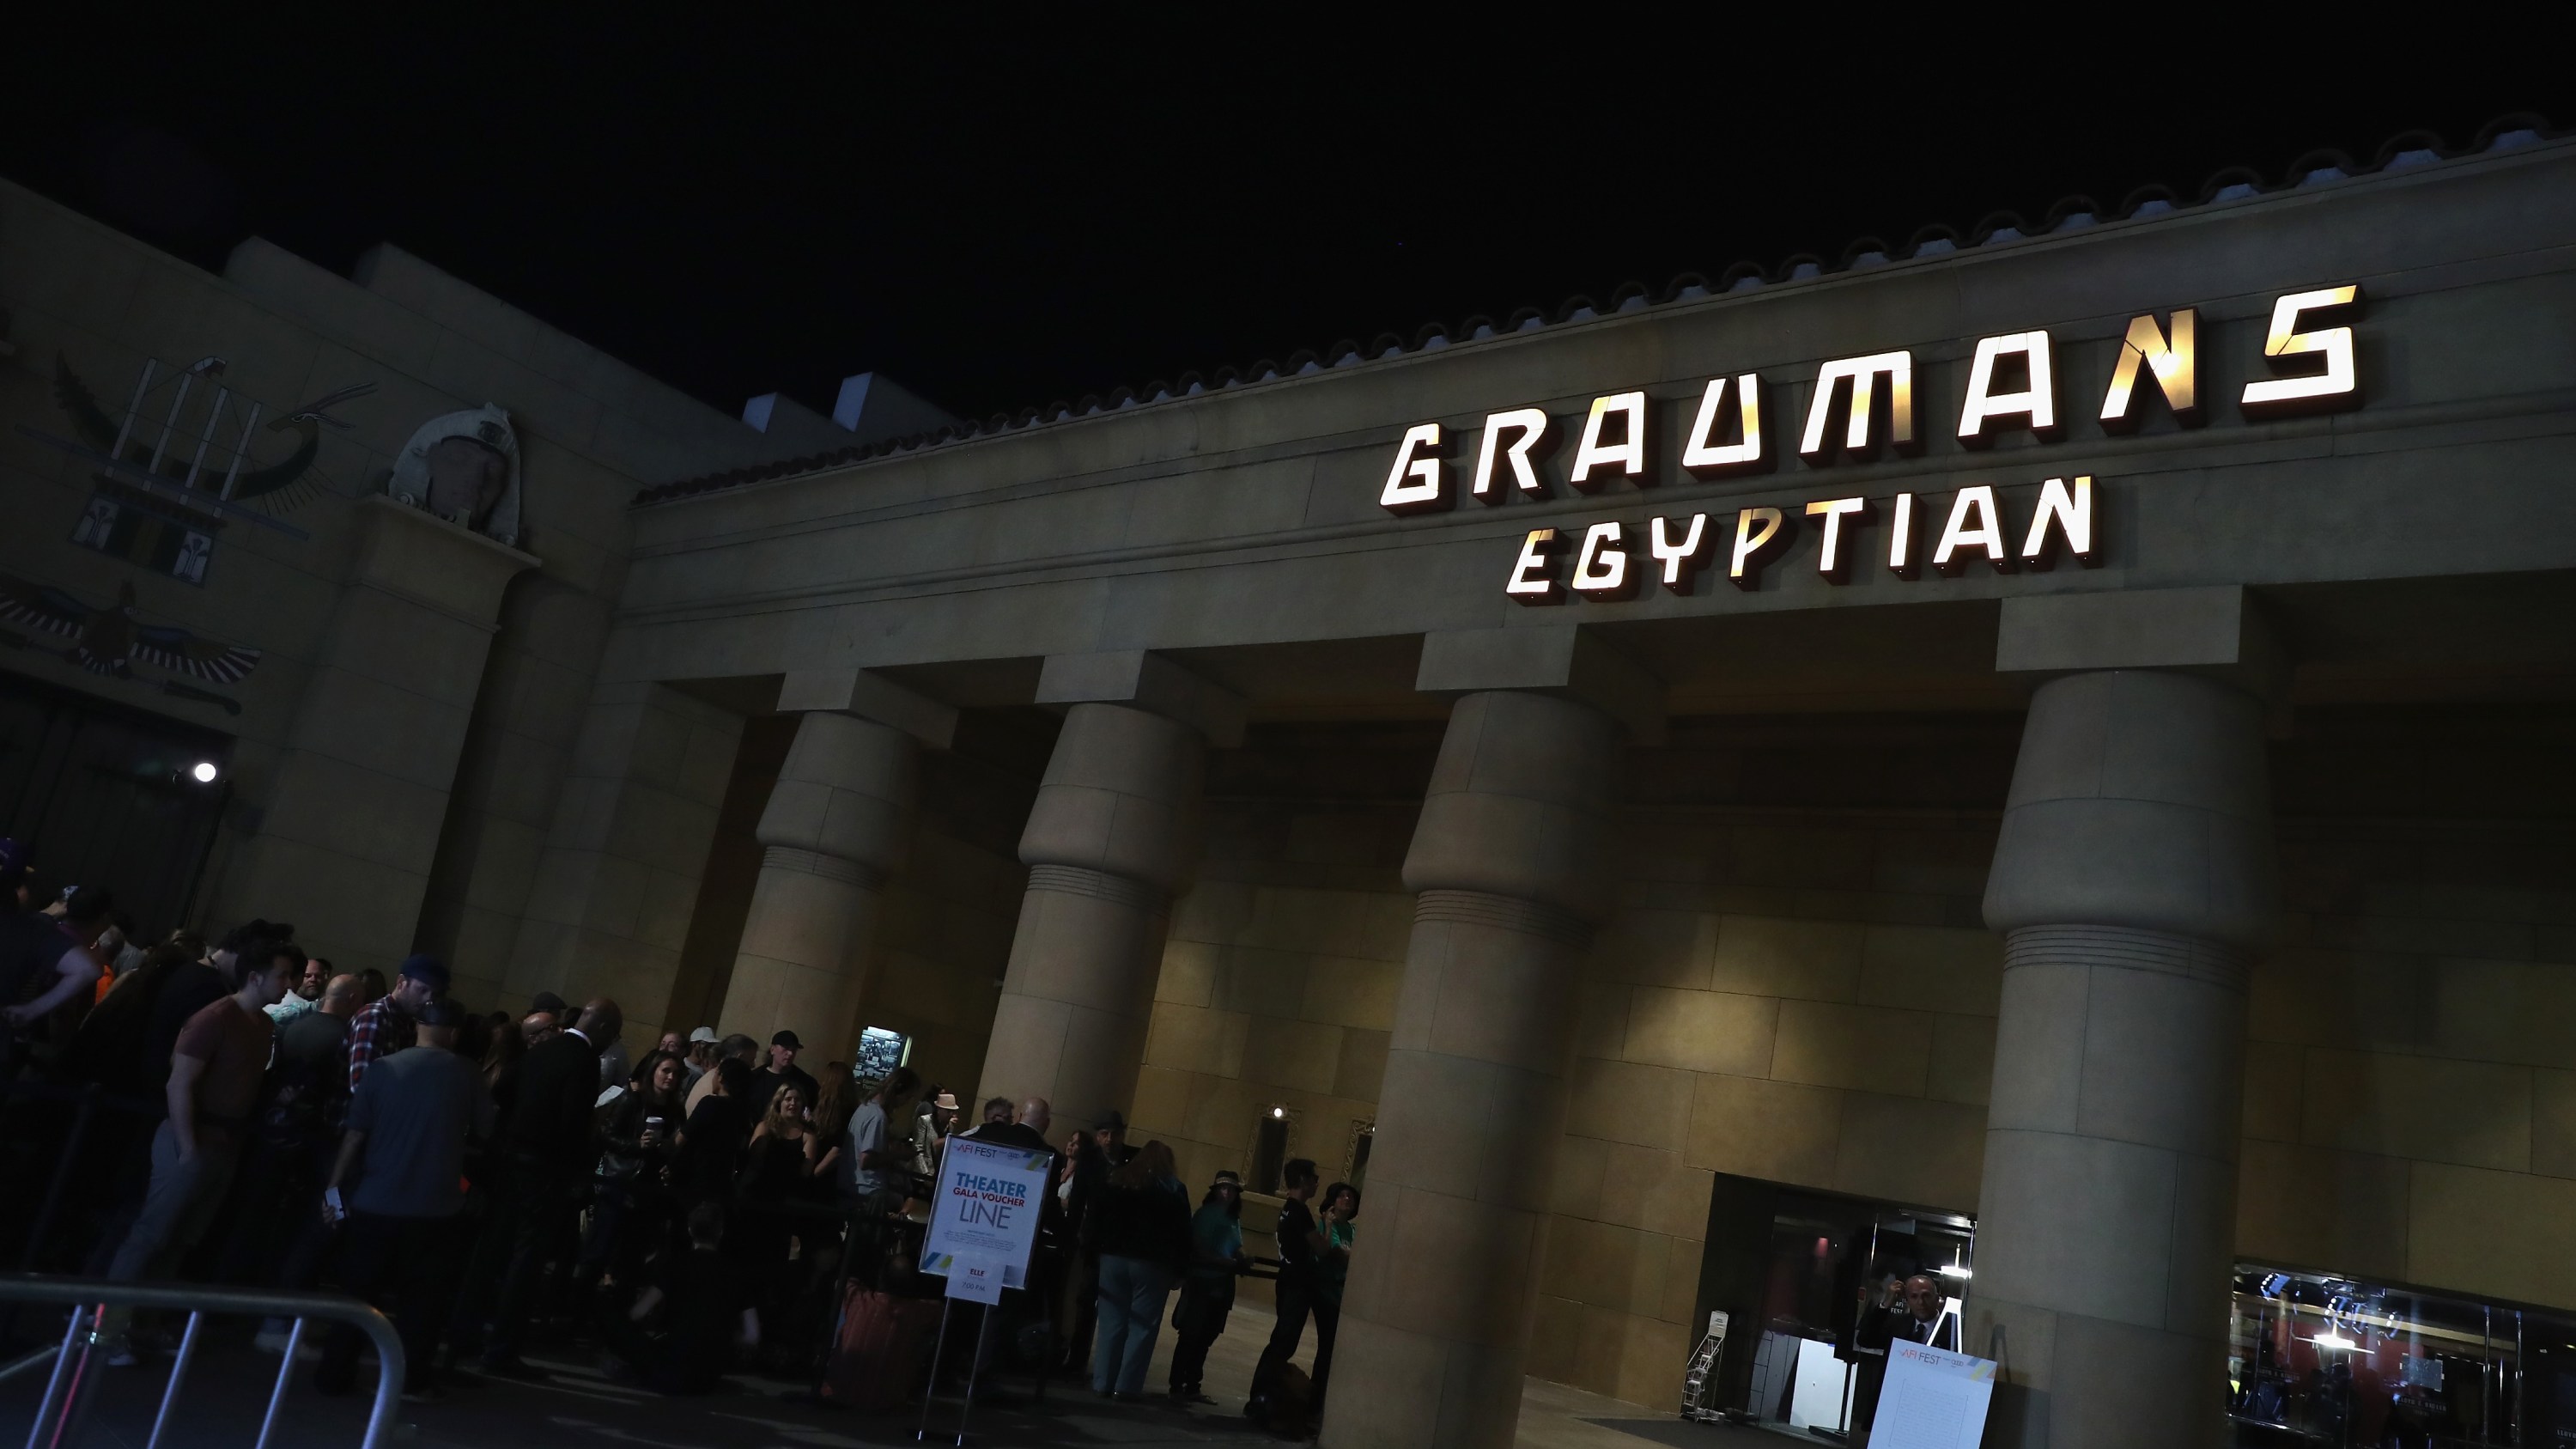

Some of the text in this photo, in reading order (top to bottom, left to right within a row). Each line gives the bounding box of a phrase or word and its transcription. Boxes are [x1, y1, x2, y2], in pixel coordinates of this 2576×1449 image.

[1379, 283, 2360, 513] GRAUMANS
[1504, 474, 2100, 601] EGYPTIAN
[957, 1143, 997, 1159] AFI FEST
[957, 1172, 1027, 1198] THEATER
[953, 1187, 1024, 1208] GALA VOUCHER
[959, 1199, 1012, 1229] LINE
[969, 1268, 985, 1277] ELLE
[1901, 1349, 1941, 1366] AFI FEST
